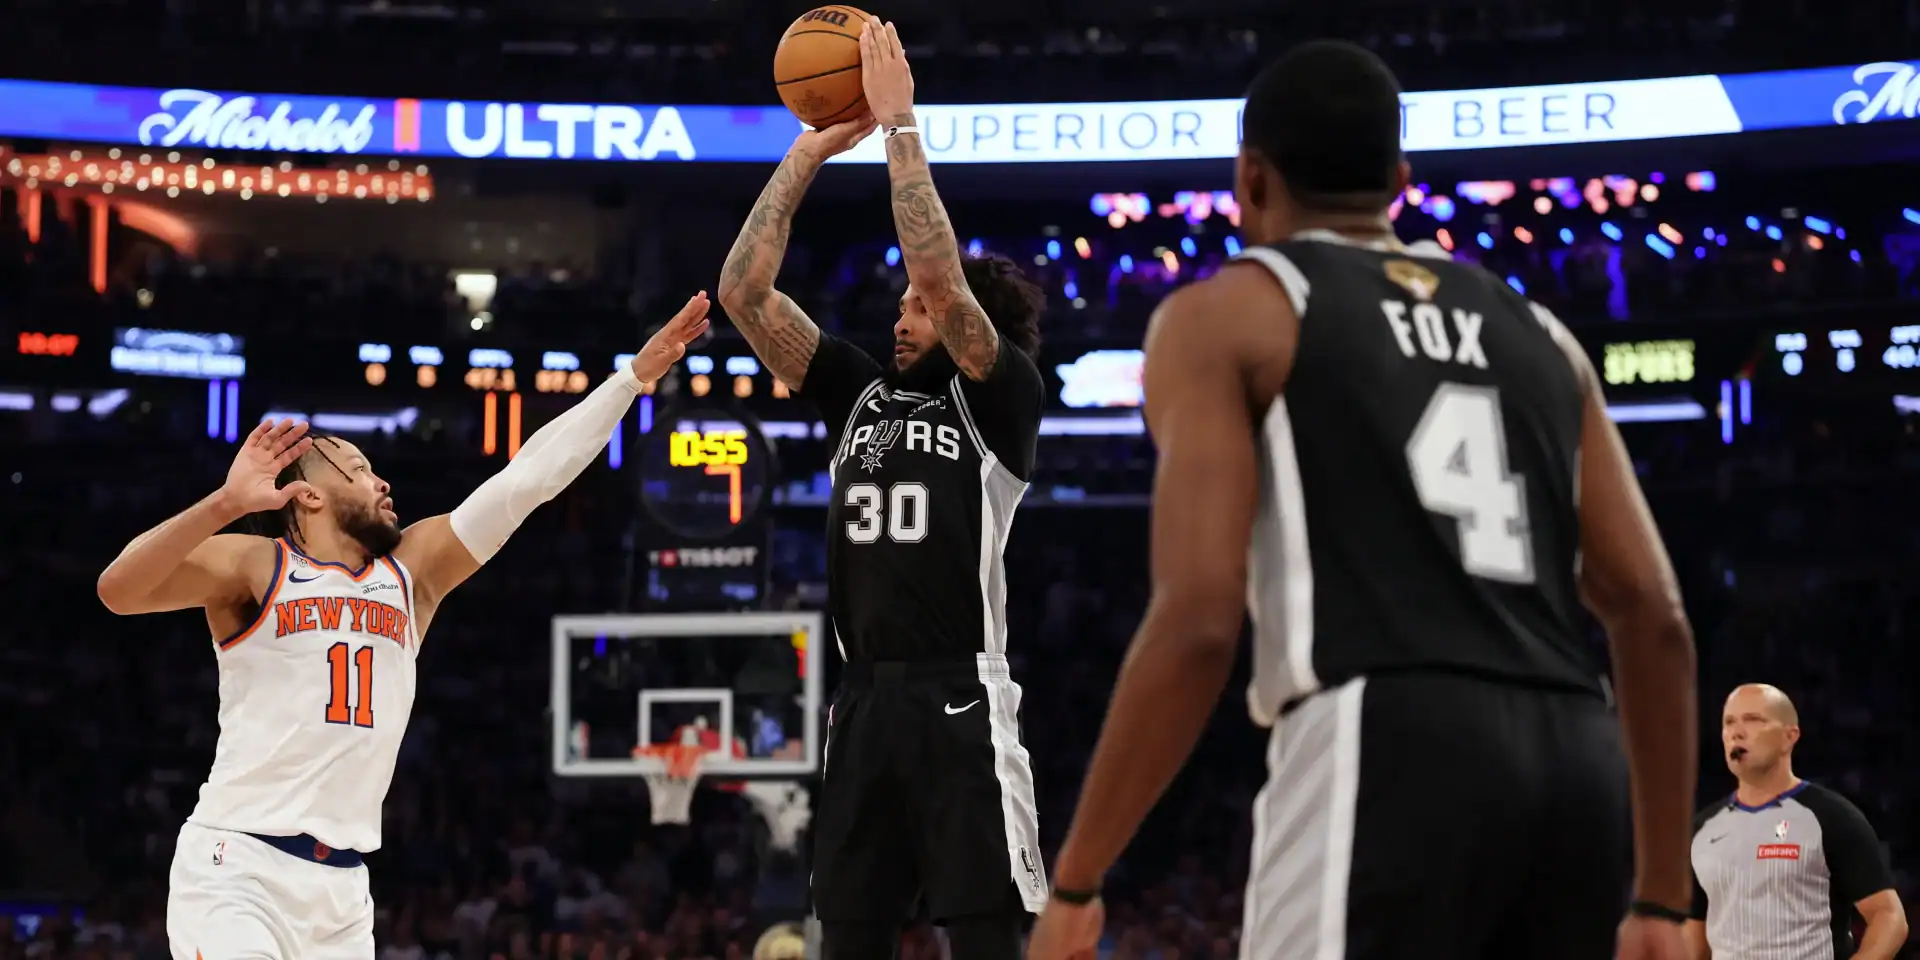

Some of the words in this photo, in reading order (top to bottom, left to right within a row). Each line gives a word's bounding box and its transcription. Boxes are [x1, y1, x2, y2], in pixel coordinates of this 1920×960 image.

[138, 89, 376, 153] Michelob
[446, 101, 696, 160] ULTRA
[925, 111, 1202, 151] UPERIOR
[1453, 93, 1616, 138] BEER
[1380, 299, 1489, 369] FOX
[669, 431, 748, 466] 10:55
[704, 464, 741, 524] 7
[845, 482, 929, 544] 30
[1404, 380, 1536, 585] 4
[275, 596, 345, 639] NEW
[346, 597, 408, 649] YORK
[325, 641, 374, 728] 11
